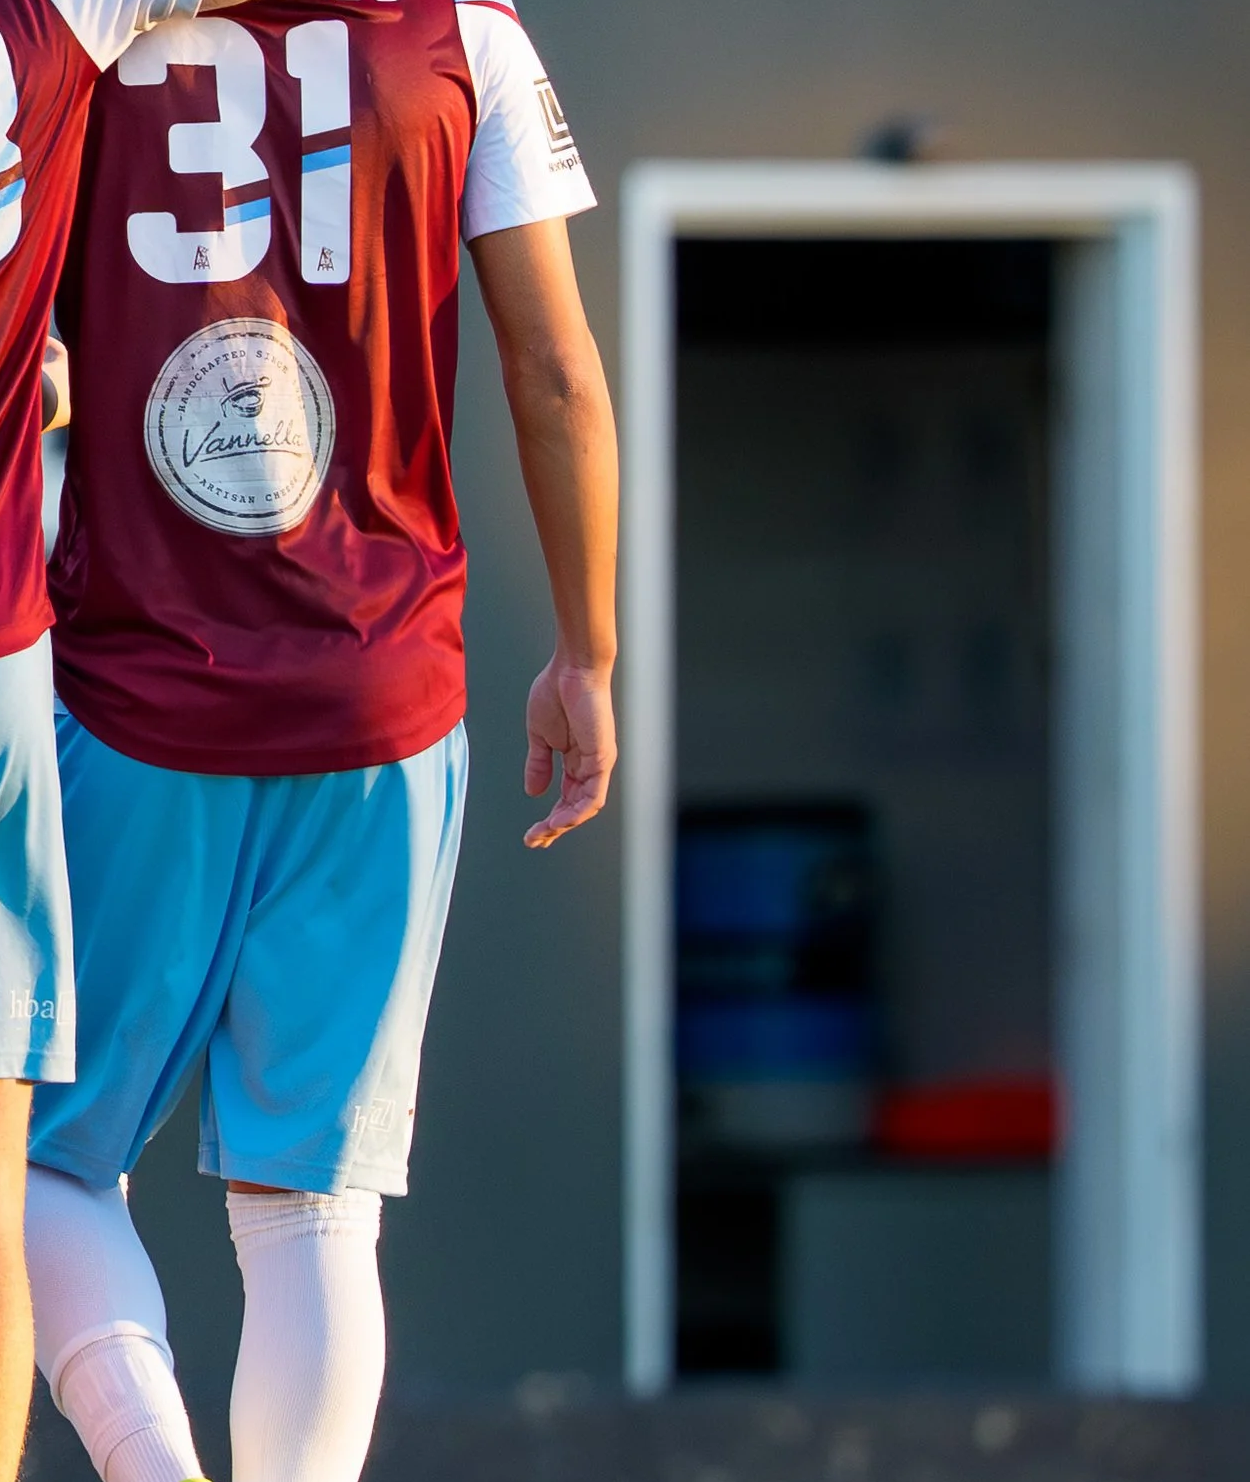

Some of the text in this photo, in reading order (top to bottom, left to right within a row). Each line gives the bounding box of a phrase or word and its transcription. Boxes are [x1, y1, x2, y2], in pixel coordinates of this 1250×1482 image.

[116, 16, 352, 285] 31
[178, 350, 247, 415] HANDCRAFTED
[255, 349, 289, 375] SINCE
[182, 419, 302, 469] Vannella
[199, 479, 256, 504] ARTISAN
